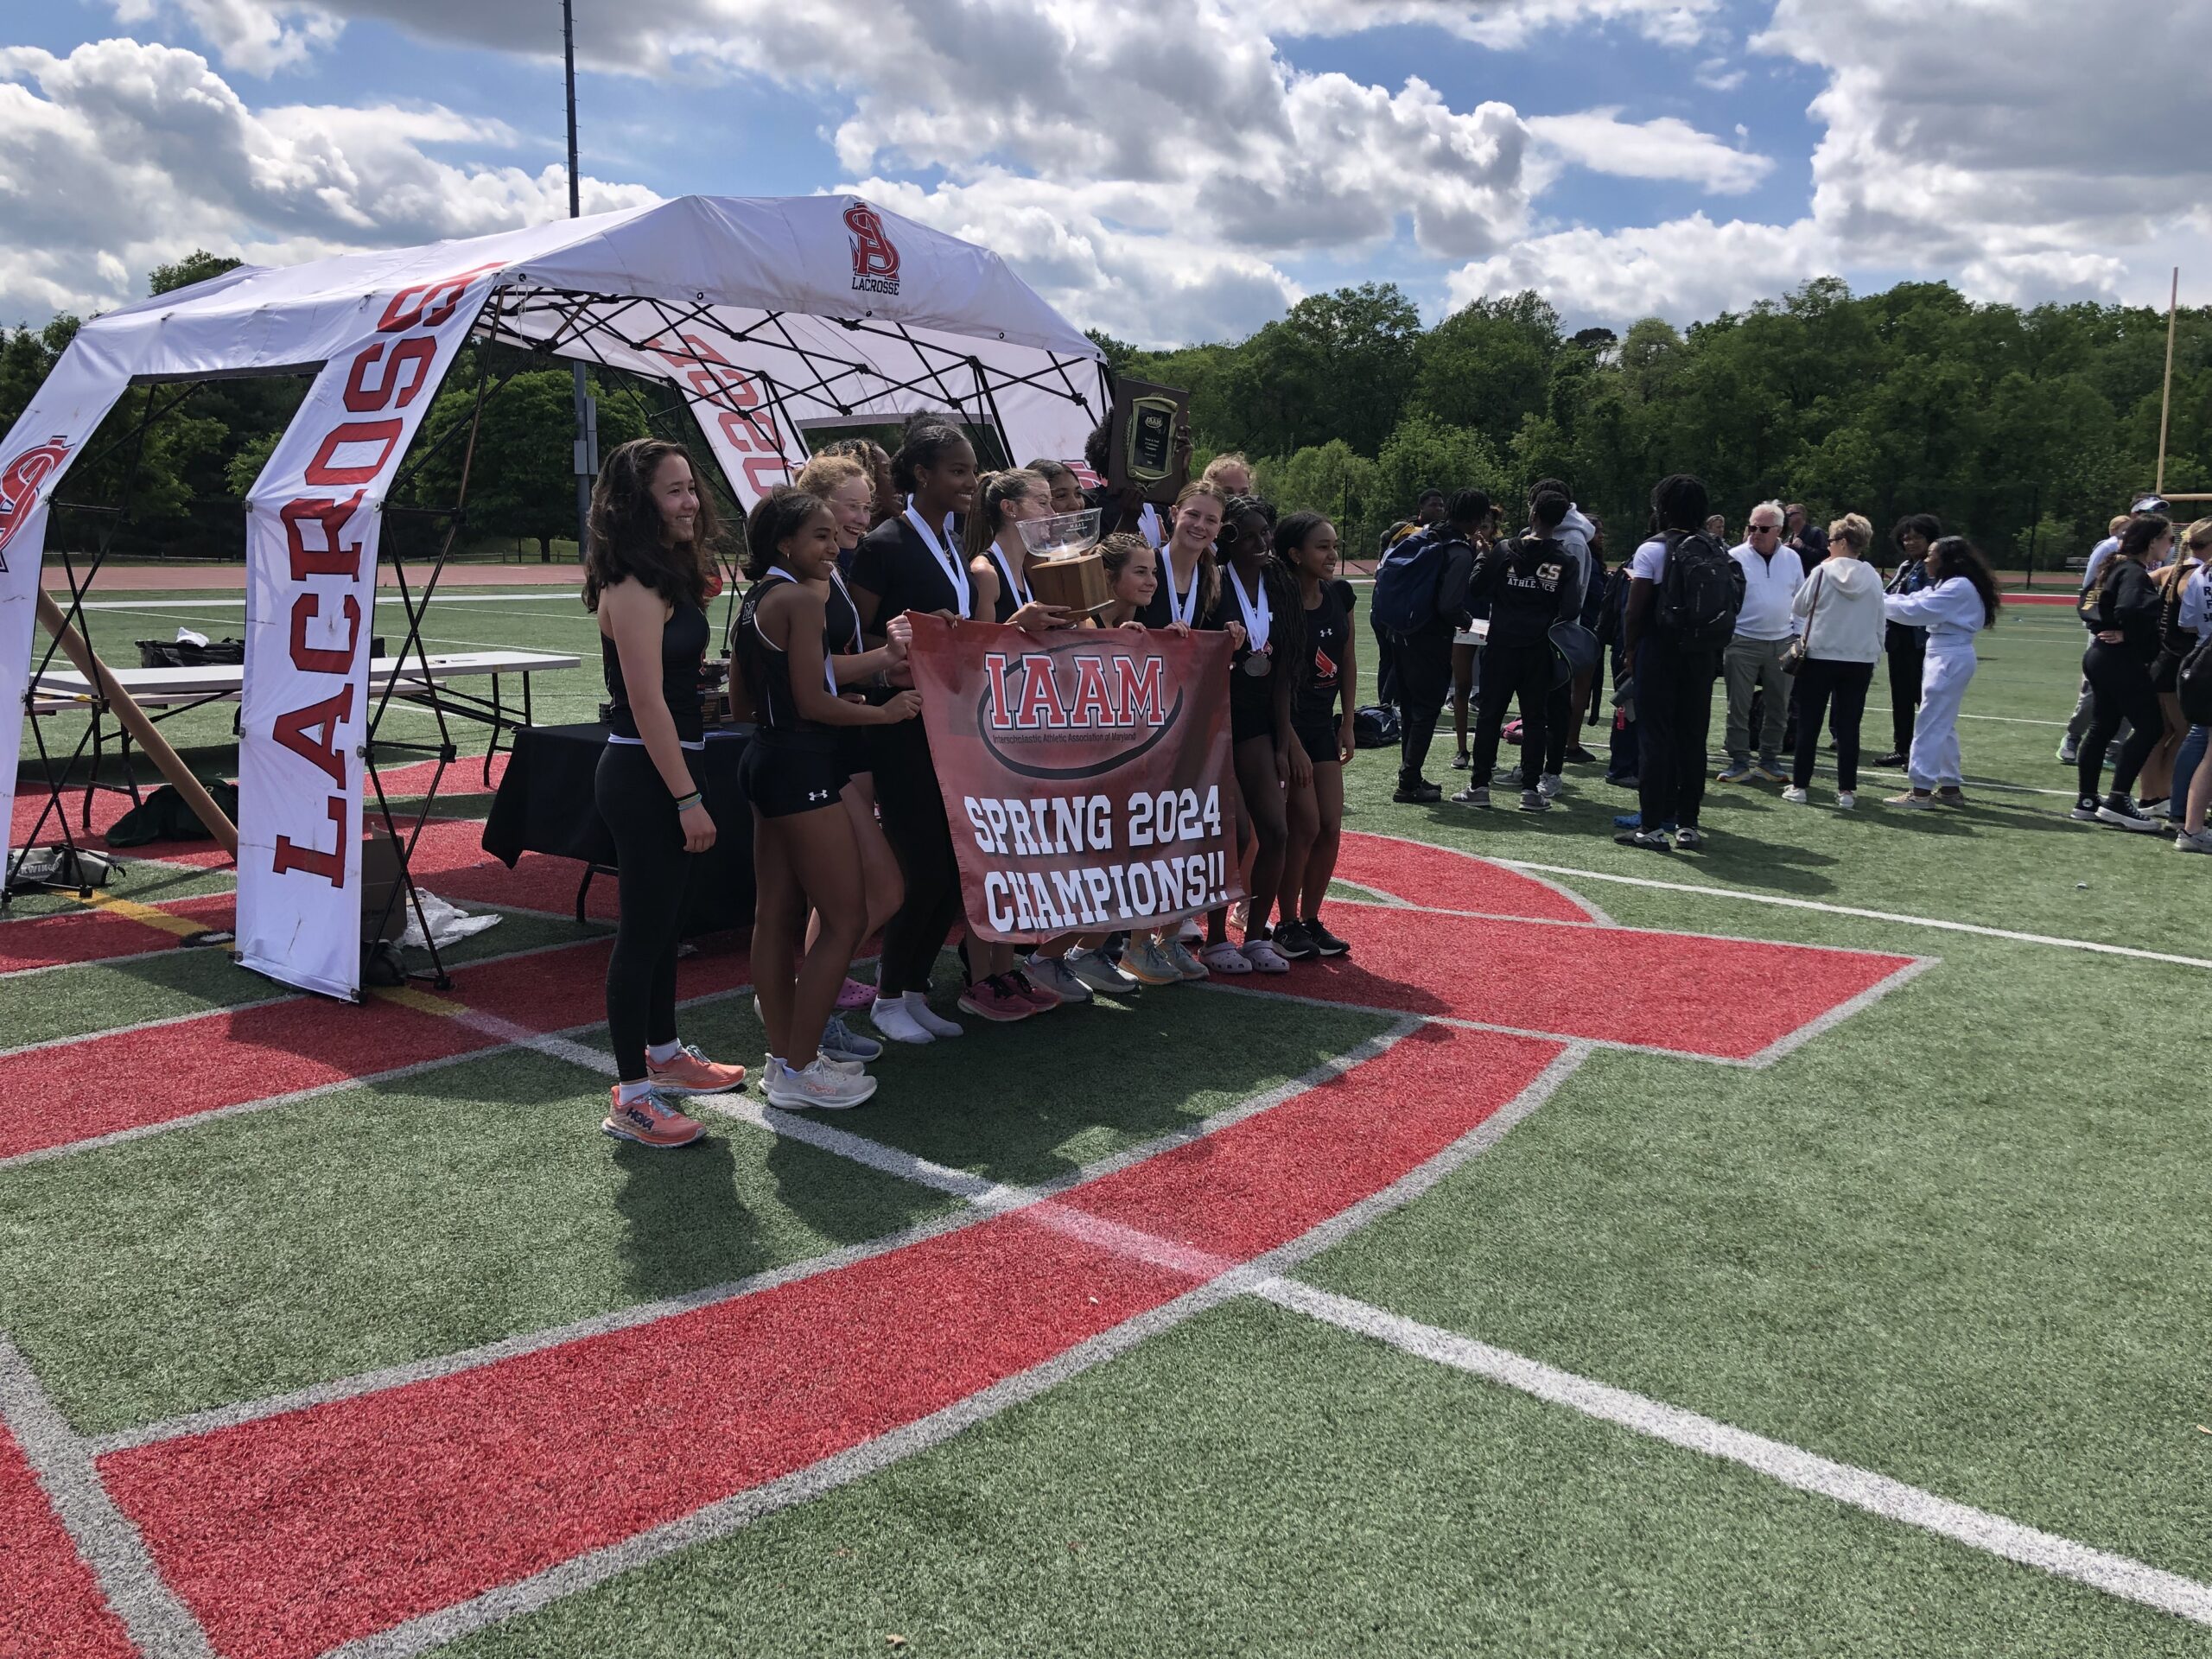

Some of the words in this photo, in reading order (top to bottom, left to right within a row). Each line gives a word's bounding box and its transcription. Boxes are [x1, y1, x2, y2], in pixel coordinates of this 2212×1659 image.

[852, 276, 899, 296] LACROSSE
[273, 262, 511, 888] LACROSS
[1507, 577, 1556, 593] ATHLEICS
[984, 652, 1166, 729] IAAM
[992, 734, 1042, 744] Interscholastic
[1043, 734, 1067, 743] Athletic
[1068, 733, 1104, 743] Association
[1112, 732, 1136, 743] Maryland
[963, 794, 1112, 855] SPRING
[1128, 785, 1221, 847] 2024
[984, 850, 1229, 932] CHAMPIONS!!
[626, 1107, 655, 1130] HOKA
